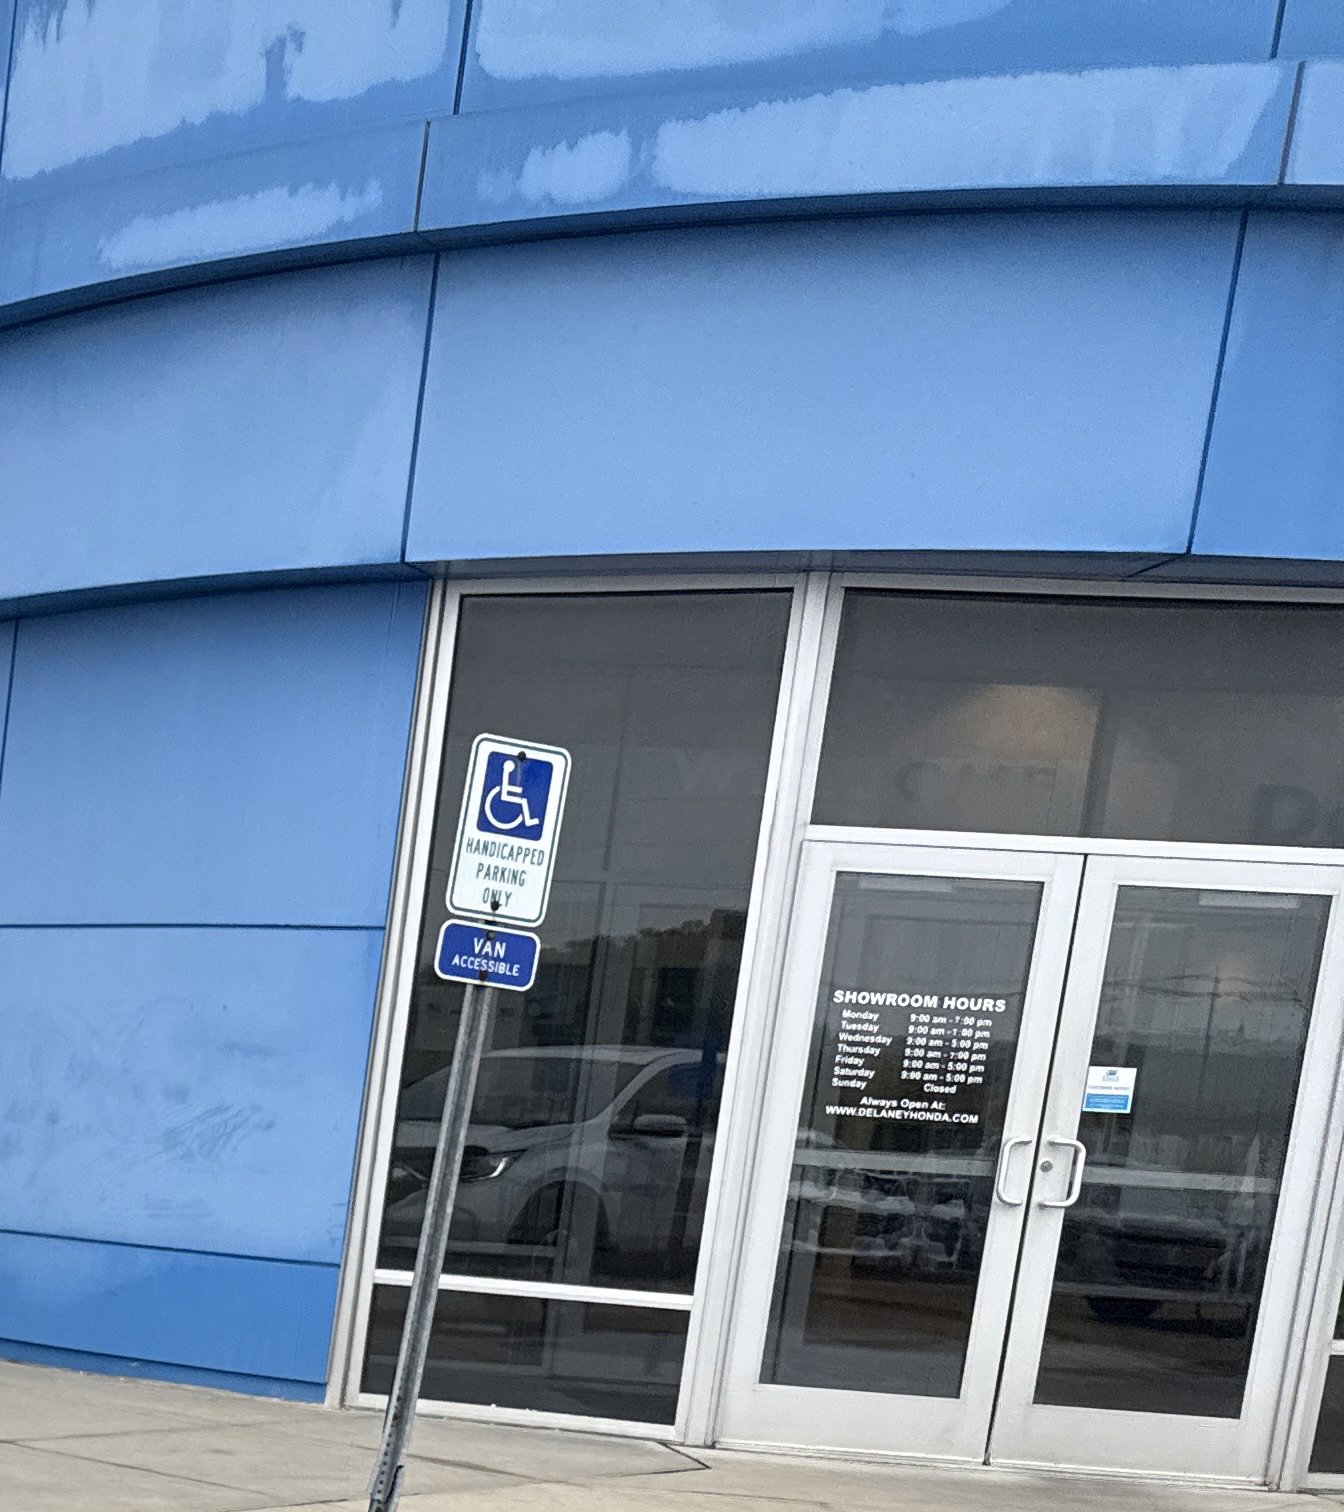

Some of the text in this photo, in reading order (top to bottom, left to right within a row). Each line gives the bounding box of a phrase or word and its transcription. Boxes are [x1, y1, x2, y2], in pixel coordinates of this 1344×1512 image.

[466, 836, 545, 867] HANDICAPPED
[475, 862, 527, 887] PARKING
[482, 887, 512, 908] ONLY
[472, 937, 507, 959] VAN
[451, 953, 521, 977] ACCESSIBLE
[833, 989, 1007, 1013] SHOWROOM HOURS
[841, 1009, 879, 1022] Monday
[932, 1016, 947, 1024] am
[976, 1019, 992, 1028] pm
[840, 1020, 880, 1033] Tuesday
[930, 1027, 945, 1036] am
[974, 1030, 991, 1039] pm
[838, 1032, 893, 1046] Wednesday
[928, 1039, 944, 1047] am
[972, 1042, 989, 1051] pm
[837, 1043, 881, 1057] Thursday
[926, 1050, 942, 1059] am
[970, 1053, 987, 1062] pm
[835, 1054, 865, 1067] Friday
[924, 1062, 940, 1070] am
[968, 1064, 985, 1073] pm
[833, 1066, 876, 1079] Saturday
[922, 1073, 938, 1081] am
[967, 1075, 983, 1085] pm
[832, 1078, 957, 1094] Sunday Closed
[860, 1096, 946, 1110] Always Open At:
[825, 1105, 979, 1124] WWW.DELANEYHONDA.COM
